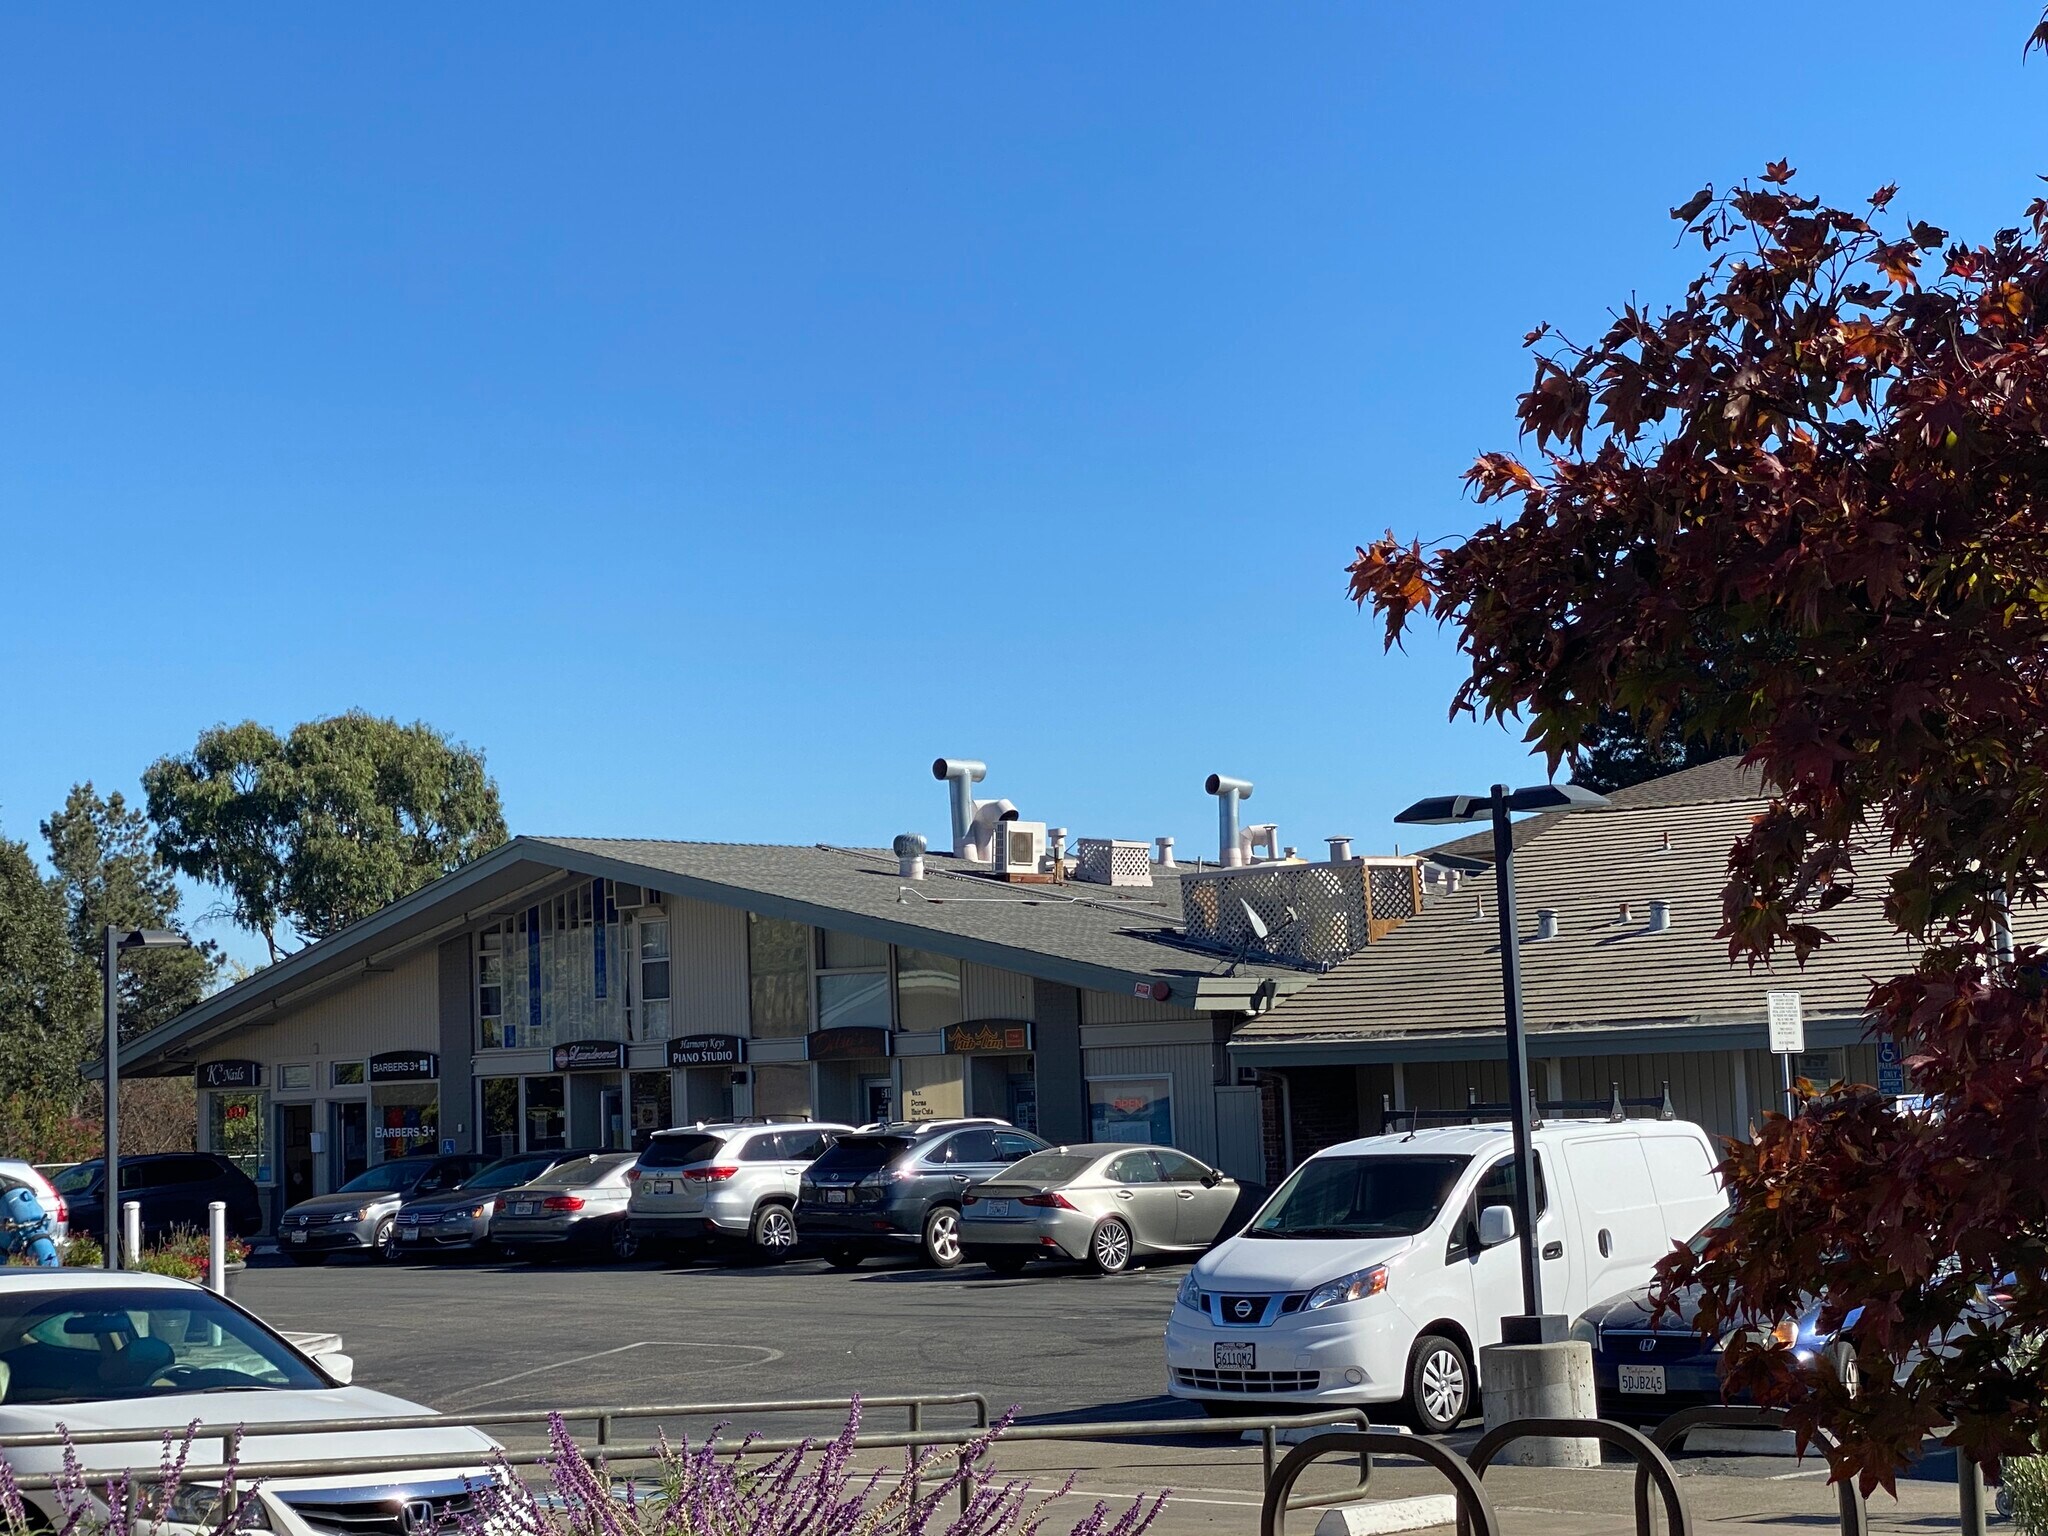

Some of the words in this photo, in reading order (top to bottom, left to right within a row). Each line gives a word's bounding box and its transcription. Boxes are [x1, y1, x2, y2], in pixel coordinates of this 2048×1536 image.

[679, 1039, 708, 1051] Harmony
[709, 1037, 726, 1050] Keys
[672, 1052, 700, 1064] PIANO
[701, 1050, 733, 1062] STUDIO
[372, 1062, 409, 1073] BARBERS
[409, 1061, 419, 1071] 3+
[206, 1063, 224, 1086] K's
[222, 1066, 245, 1082] Nails
[1113, 1097, 1144, 1109] OPEN
[374, 1126, 420, 1138] BARBERS
[421, 1125, 436, 1137] 3+
[1622, 1375, 1662, 1390] 5DJB245
